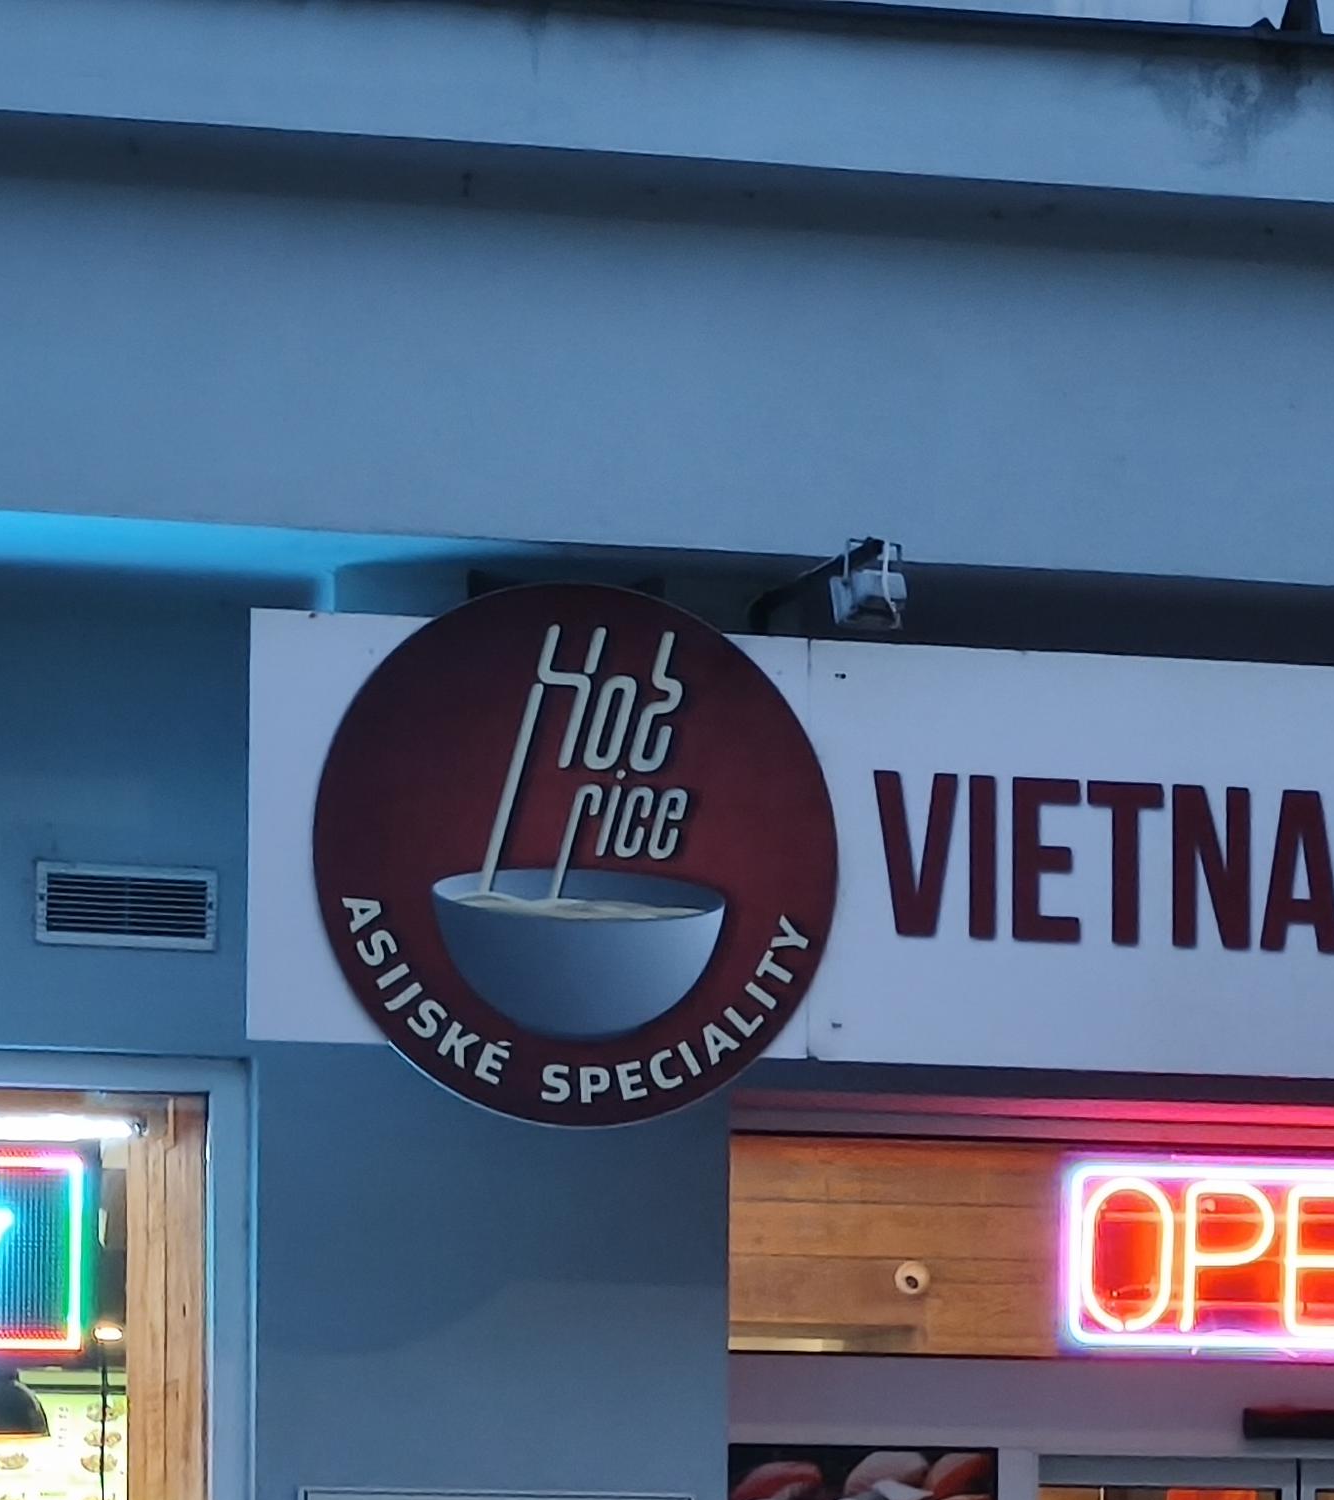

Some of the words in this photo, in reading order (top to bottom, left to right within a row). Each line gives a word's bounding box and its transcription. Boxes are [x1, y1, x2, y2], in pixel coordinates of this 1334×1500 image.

[551, 769, 688, 898] rice
[341, 896, 512, 1085] ASIJSKÉ
[540, 914, 809, 1104] SPECIALITY
